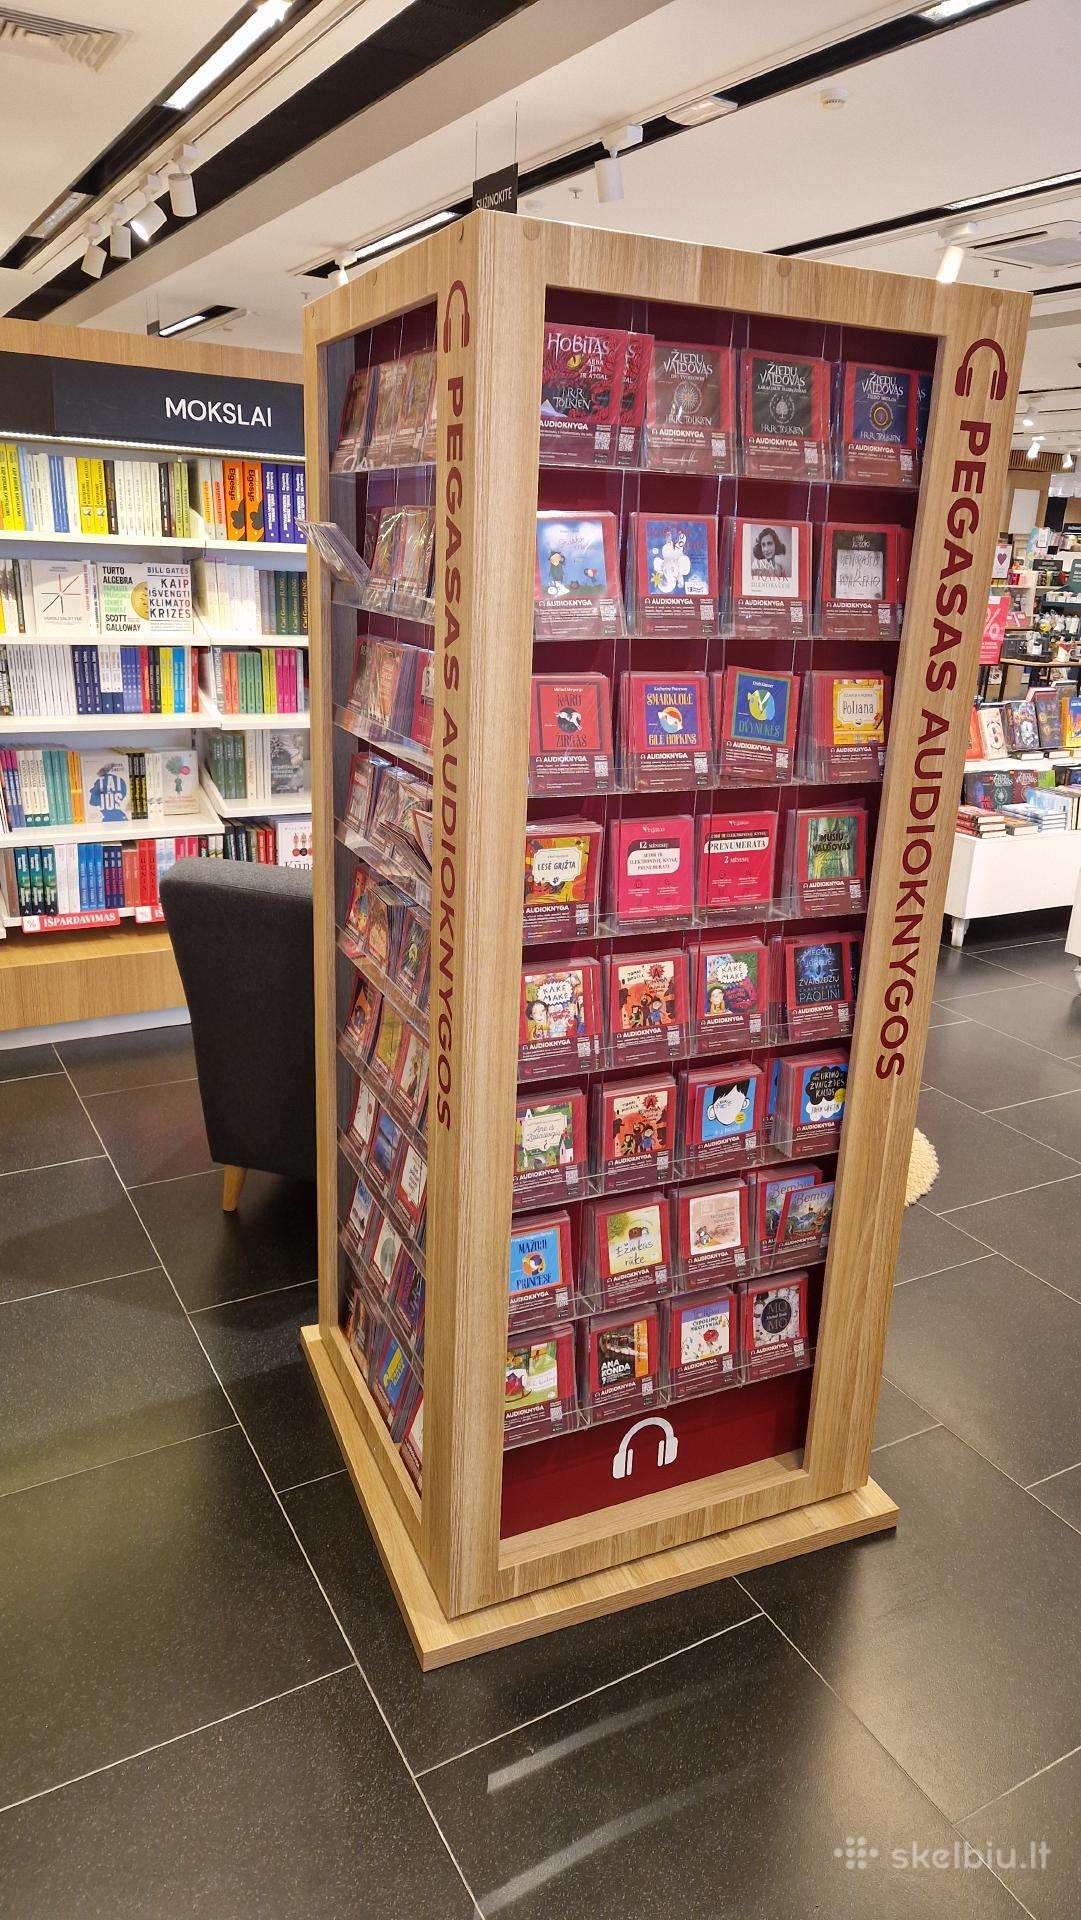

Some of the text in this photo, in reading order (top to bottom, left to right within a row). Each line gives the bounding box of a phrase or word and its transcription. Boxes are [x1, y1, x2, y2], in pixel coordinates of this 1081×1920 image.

[547, 332, 610, 359] HOBITAS
[663, 361, 713, 376] VALDOVAS
[759, 371, 806, 388] VALDOVAS
[861, 380, 904, 397] VALDOVAS
[553, 396, 591, 410] TOLKIEN
[165, 397, 272, 427] MOKSLAI
[539, 420, 588, 430] AUDIOKNYGA
[659, 429, 704, 438] AUDIOKNYGA
[755, 438, 798, 447] AUDIOKNYGA
[855, 444, 894, 454] AUDIOKNYGA
[228, 468, 236, 501] Elgesys
[443, 376, 464, 692] PEGASAS
[926, 419, 992, 693] PEGASAS
[102, 566, 125, 575] TURTO
[166, 567, 189, 575] GATES
[102, 576, 133, 585] ALGEBRA
[161, 578, 189, 588] KAIP
[149, 588, 190, 598] IŠVENGTI
[150, 599, 191, 607] KLIMATO
[546, 599, 592, 607] AUDIOKNYGA
[651, 598, 694, 606] AUDIOKNYGA
[744, 599, 784, 607] AUDIOKNYGA
[105, 614, 127, 622] SCOTT
[106, 624, 141, 632] GALLOWAY
[842, 701, 874, 715] Poliana
[732, 742, 771, 752] AUDIOKNYGA
[646, 752, 688, 760] AUDIOKNYGA
[639, 840, 647, 849] 12
[708, 840, 766, 851] PRENUMERATA
[724, 856, 729, 864] 2
[875, 708, 950, 1080] AUDIOKNYGOS
[525, 904, 570, 914] AUDIOKNYGA
[436, 707, 459, 1131] AUDIOKNYGOS
[800, 989, 841, 1002] PAOLINI
[798, 1005, 833, 1014] AUDIOKNYGA
[707, 1016, 744, 1025] AUDIOKNYGA
[623, 1028, 661, 1038] AUDIOKNYGA
[529, 1039, 571, 1049] AUDIOKNYGA
[802, 1122, 835, 1131] AUDIOKNYGA
[704, 1136, 740, 1148] AUDIOKNYGA
[614, 1154, 652, 1165] AUDIOKNYGA
[520, 1169, 559, 1180] AUDIOKNYGA
[785, 1236, 816, 1246] AUDIOKNYGA
[694, 1252, 728, 1262] AUDIOKNYGA
[613, 1269, 649, 1281] AUDIOKNYGA
[510, 1291, 549, 1304] AUDIOKNYGA
[757, 1343, 788, 1354] AUDIOKNYGA
[601, 1359, 619, 1370] ANA
[684, 1359, 716, 1371] AUDIOKNYGA
[601, 1363, 630, 1377] KONDA
[601, 1382, 636, 1395] AUDIOKNYGA
[506, 1405, 544, 1418] AUDIOKNYGA
